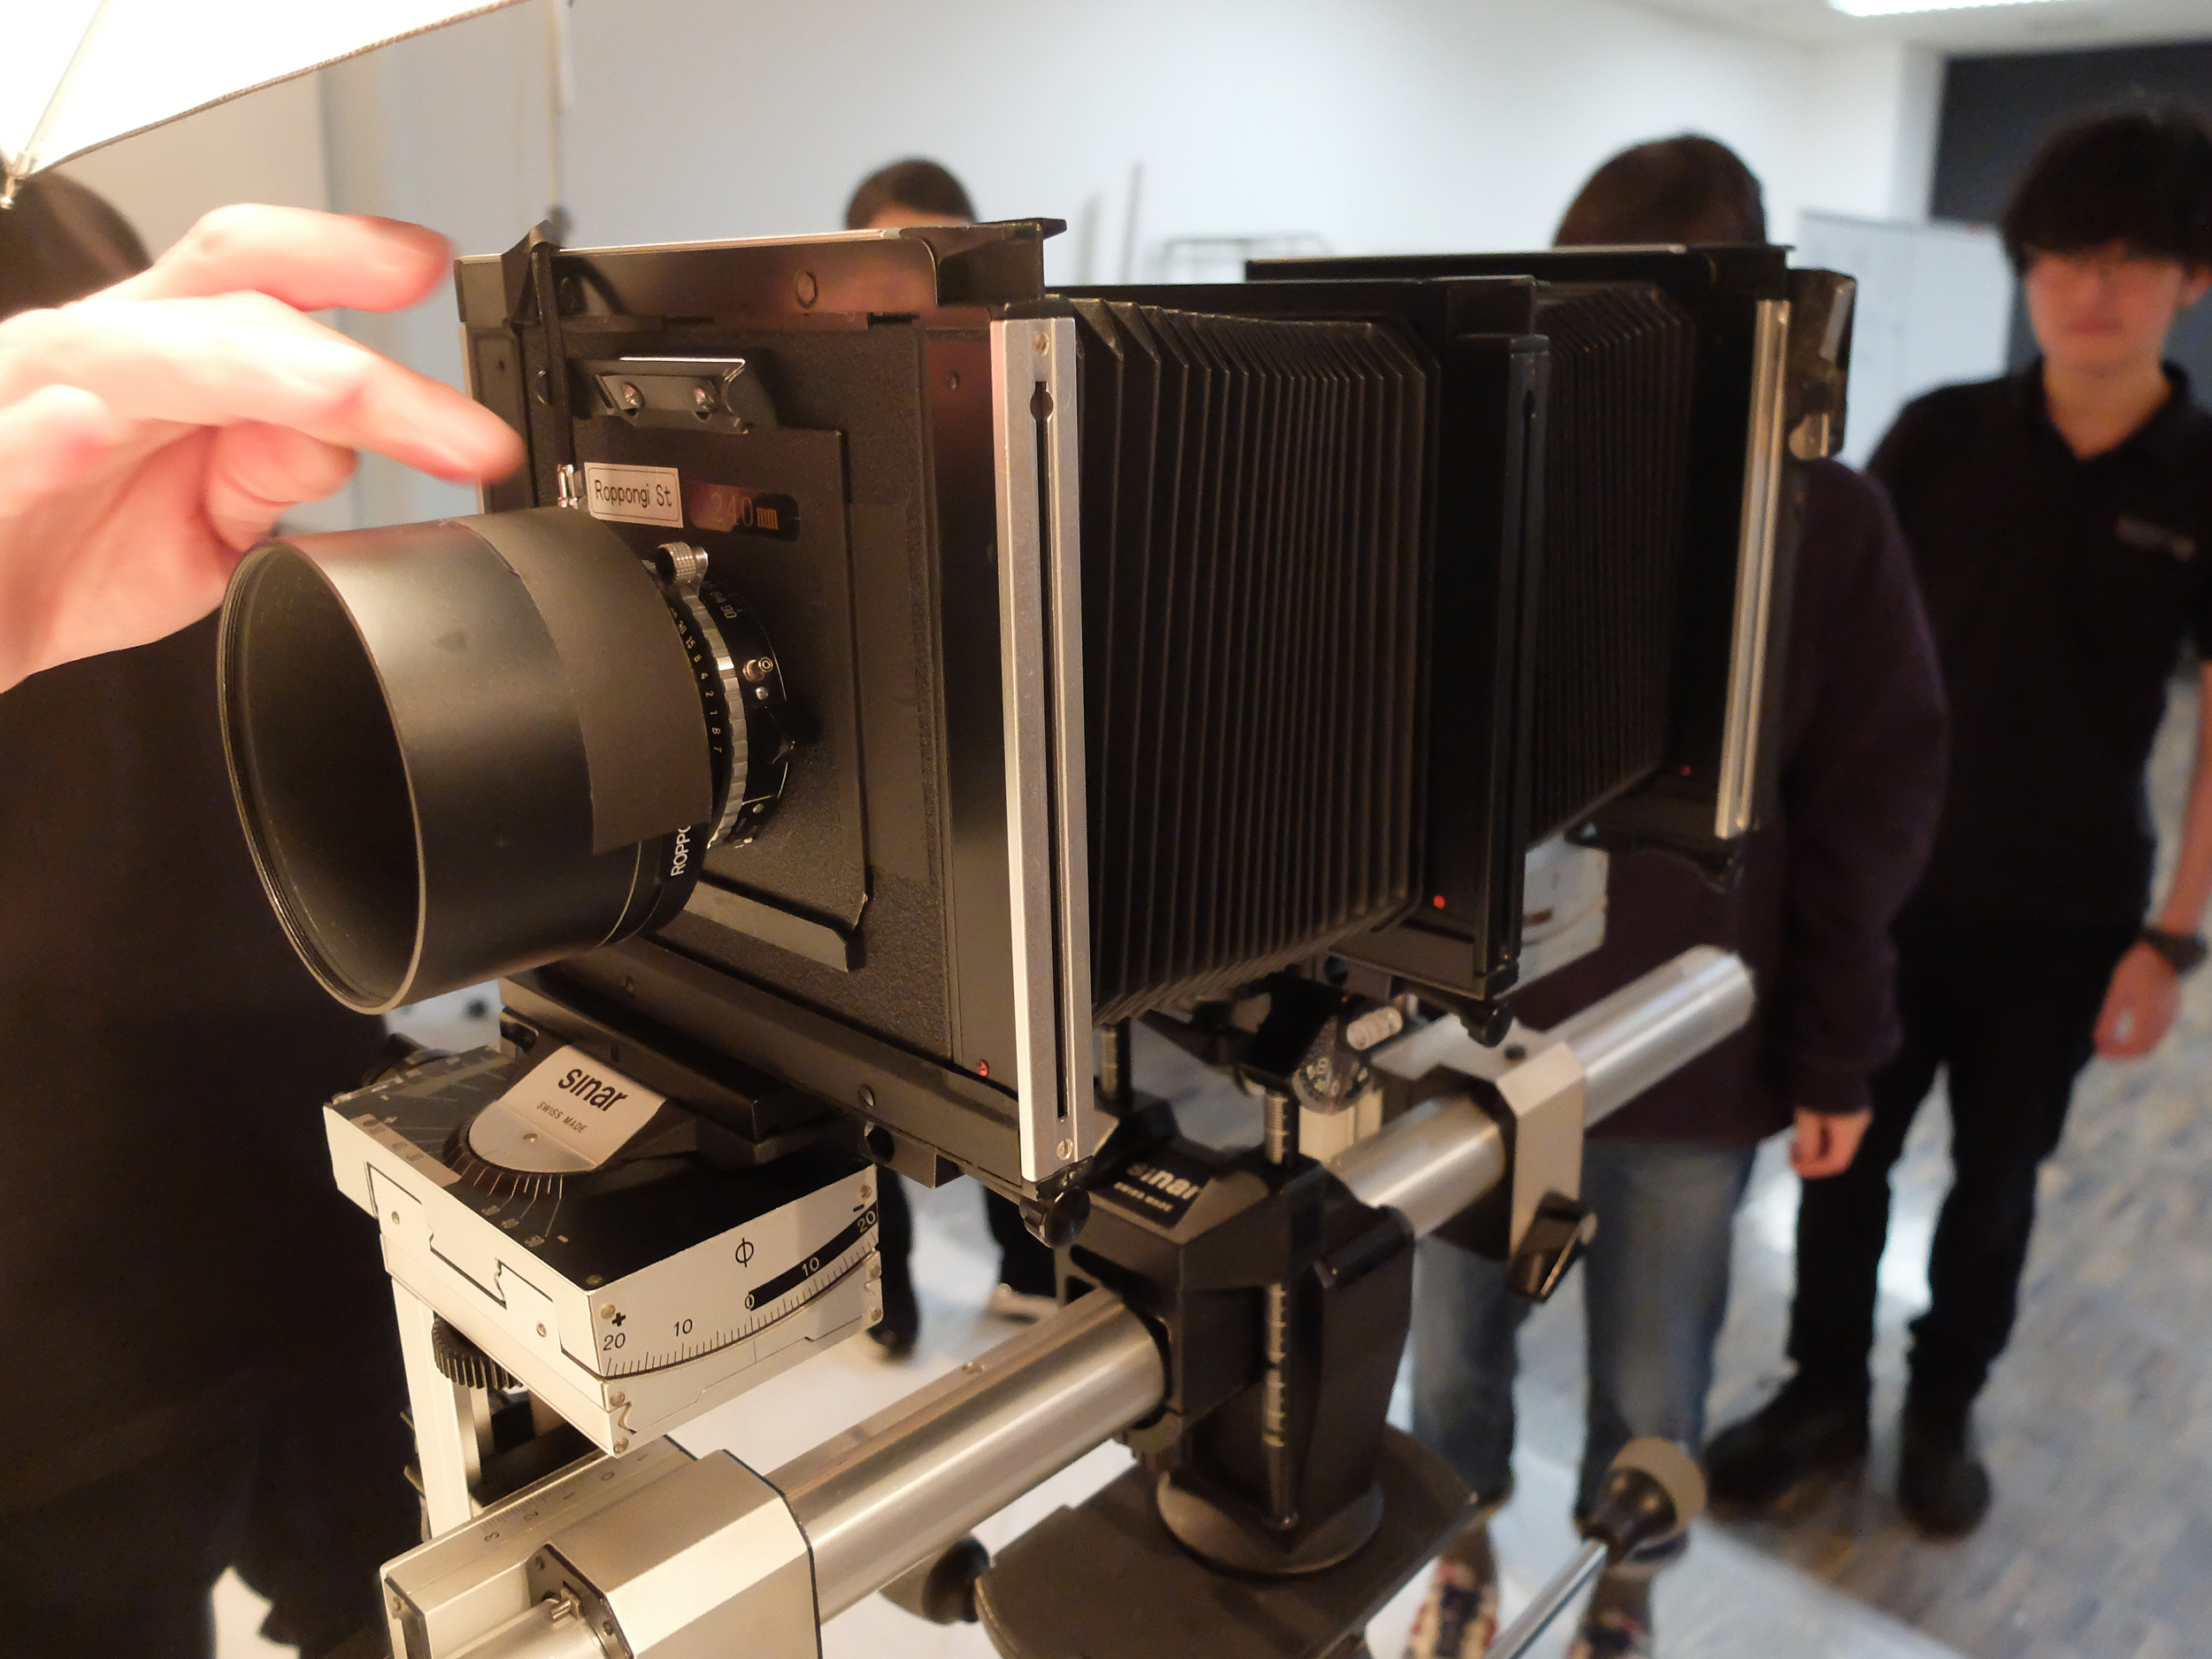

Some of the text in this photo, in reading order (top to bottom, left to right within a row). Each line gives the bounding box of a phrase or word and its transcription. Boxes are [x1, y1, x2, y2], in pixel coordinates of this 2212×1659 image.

[595, 480, 672, 508] Roppongi St
[720, 604, 737, 618] 90
[686, 636, 695, 649] 15
[711, 726, 721, 735] B
[536, 1101, 588, 1133] SWISS MADE
[603, 1210, 876, 1351] 20 10 0 10 20
